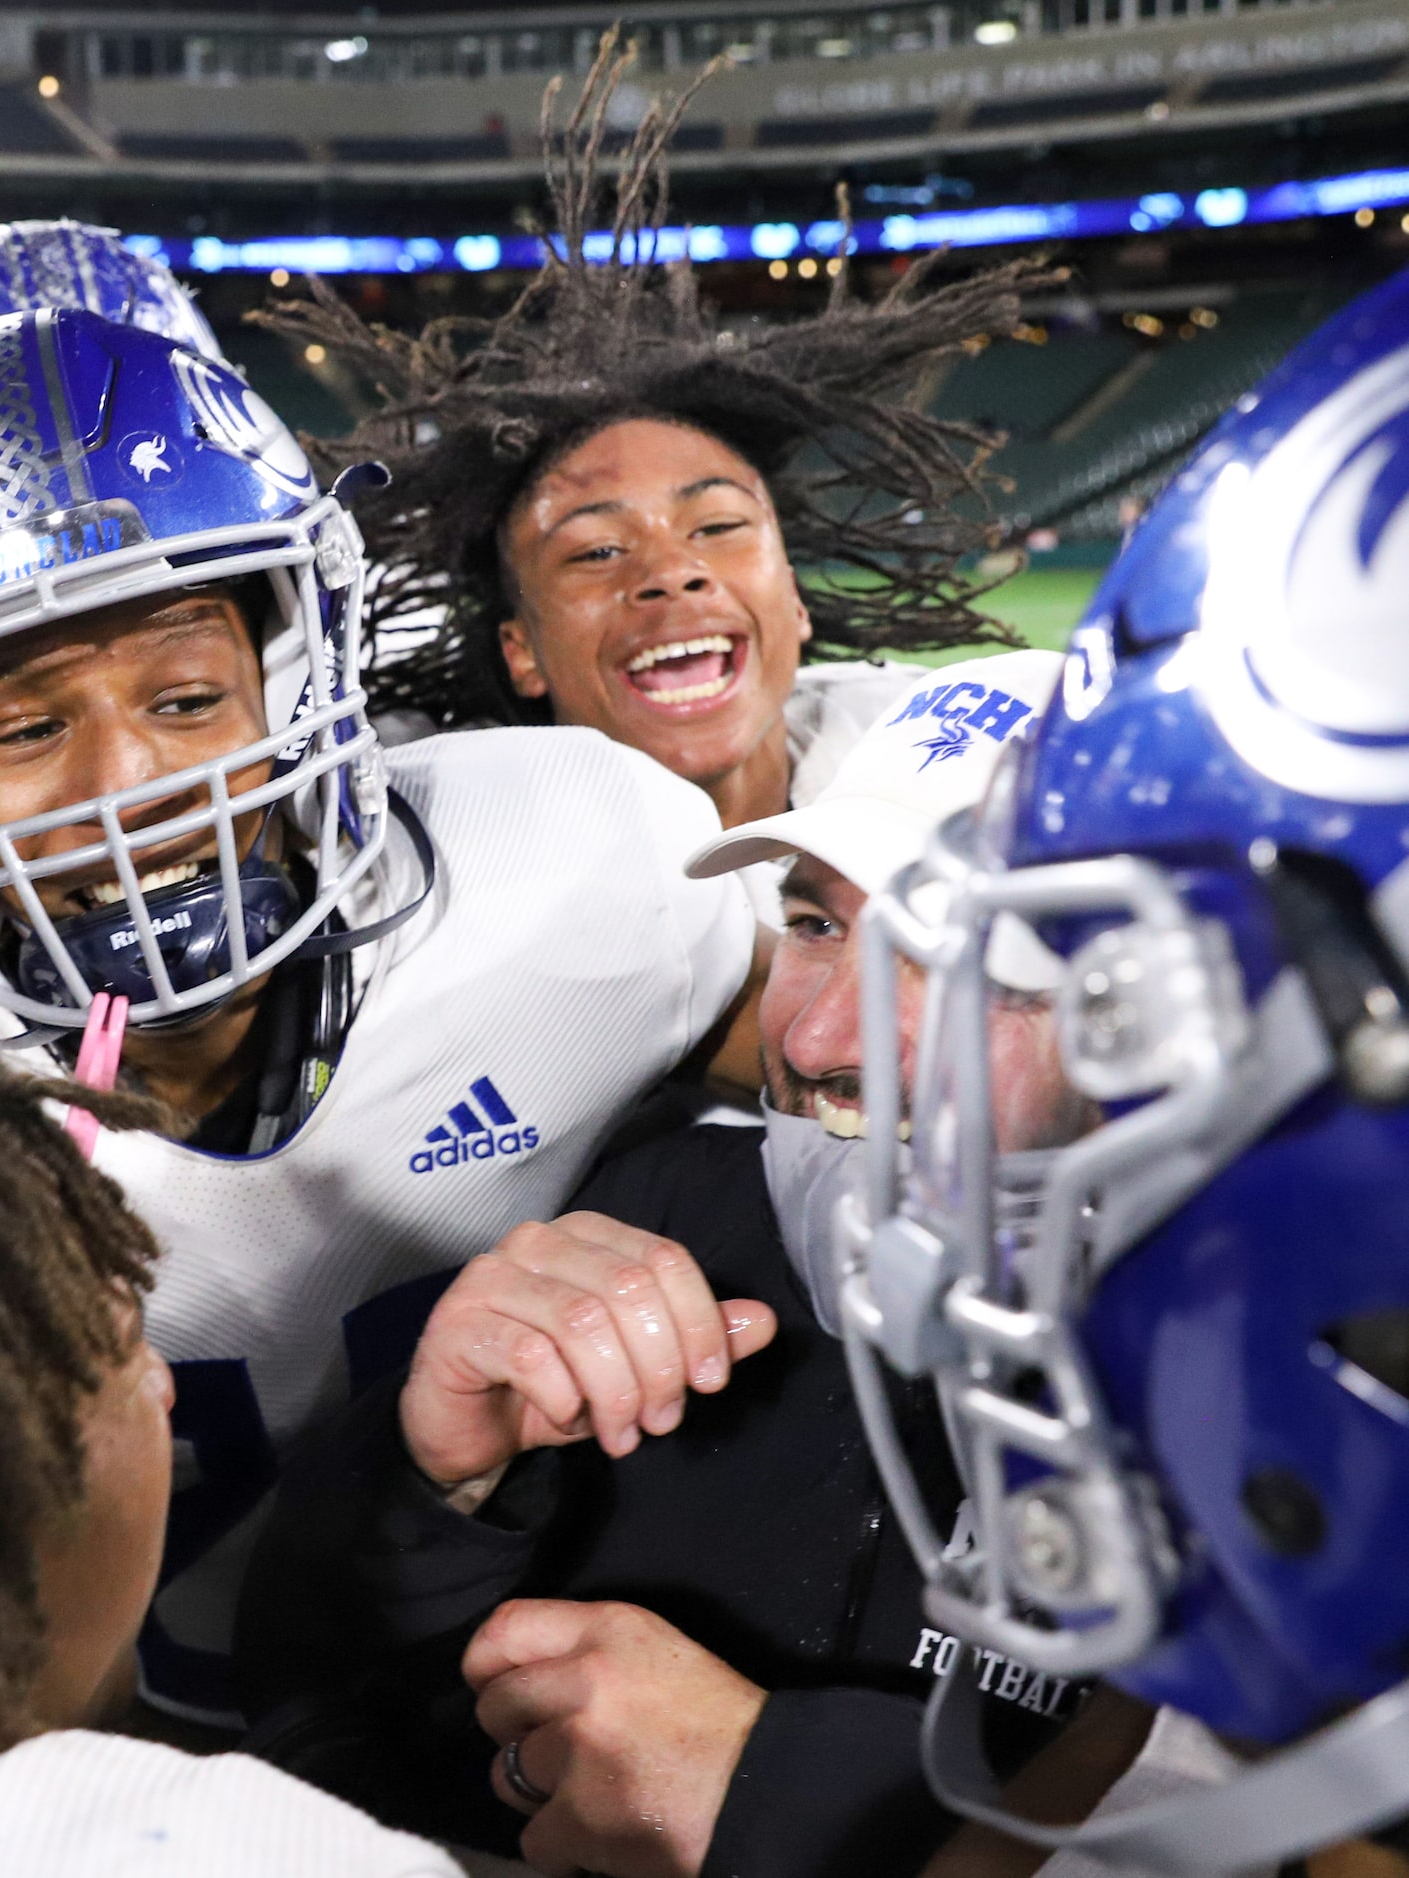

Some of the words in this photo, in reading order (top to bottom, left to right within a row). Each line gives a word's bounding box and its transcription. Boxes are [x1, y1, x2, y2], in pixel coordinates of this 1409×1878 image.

[885, 682, 1047, 742] NCH
[409, 1126, 540, 1174] adidas
[909, 1627, 1090, 1718] FOTBAL
